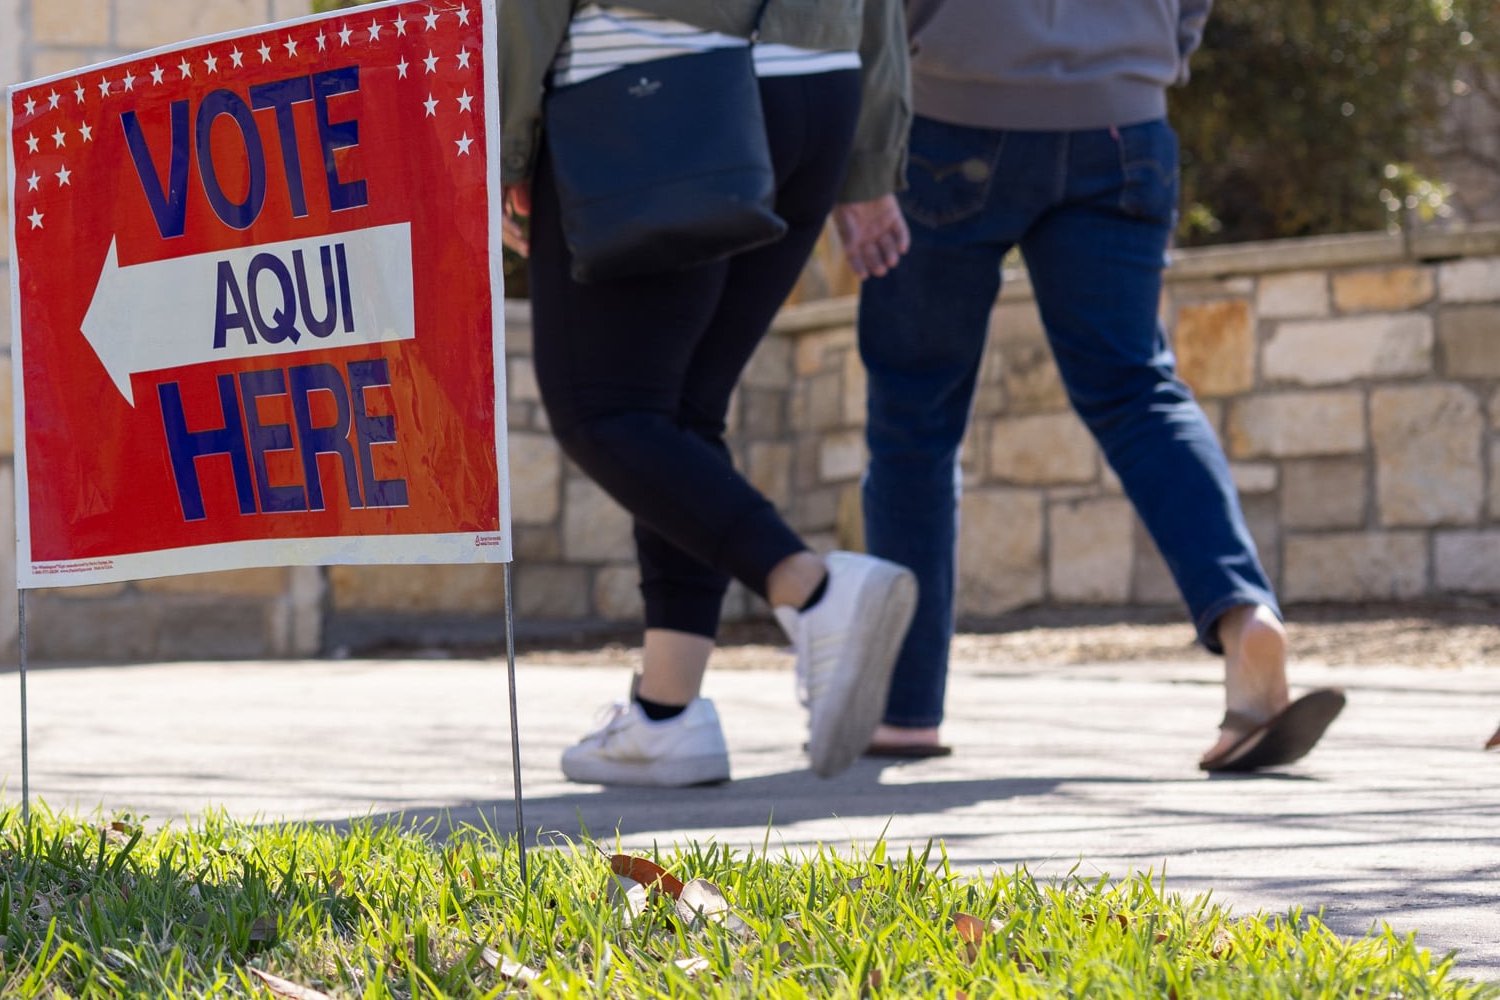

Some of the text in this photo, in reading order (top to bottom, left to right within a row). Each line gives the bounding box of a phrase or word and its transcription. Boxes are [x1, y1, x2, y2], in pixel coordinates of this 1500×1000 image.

[120, 65, 368, 239] VOTE
[213, 243, 355, 349] AQUI
[156, 358, 409, 522] HERE
